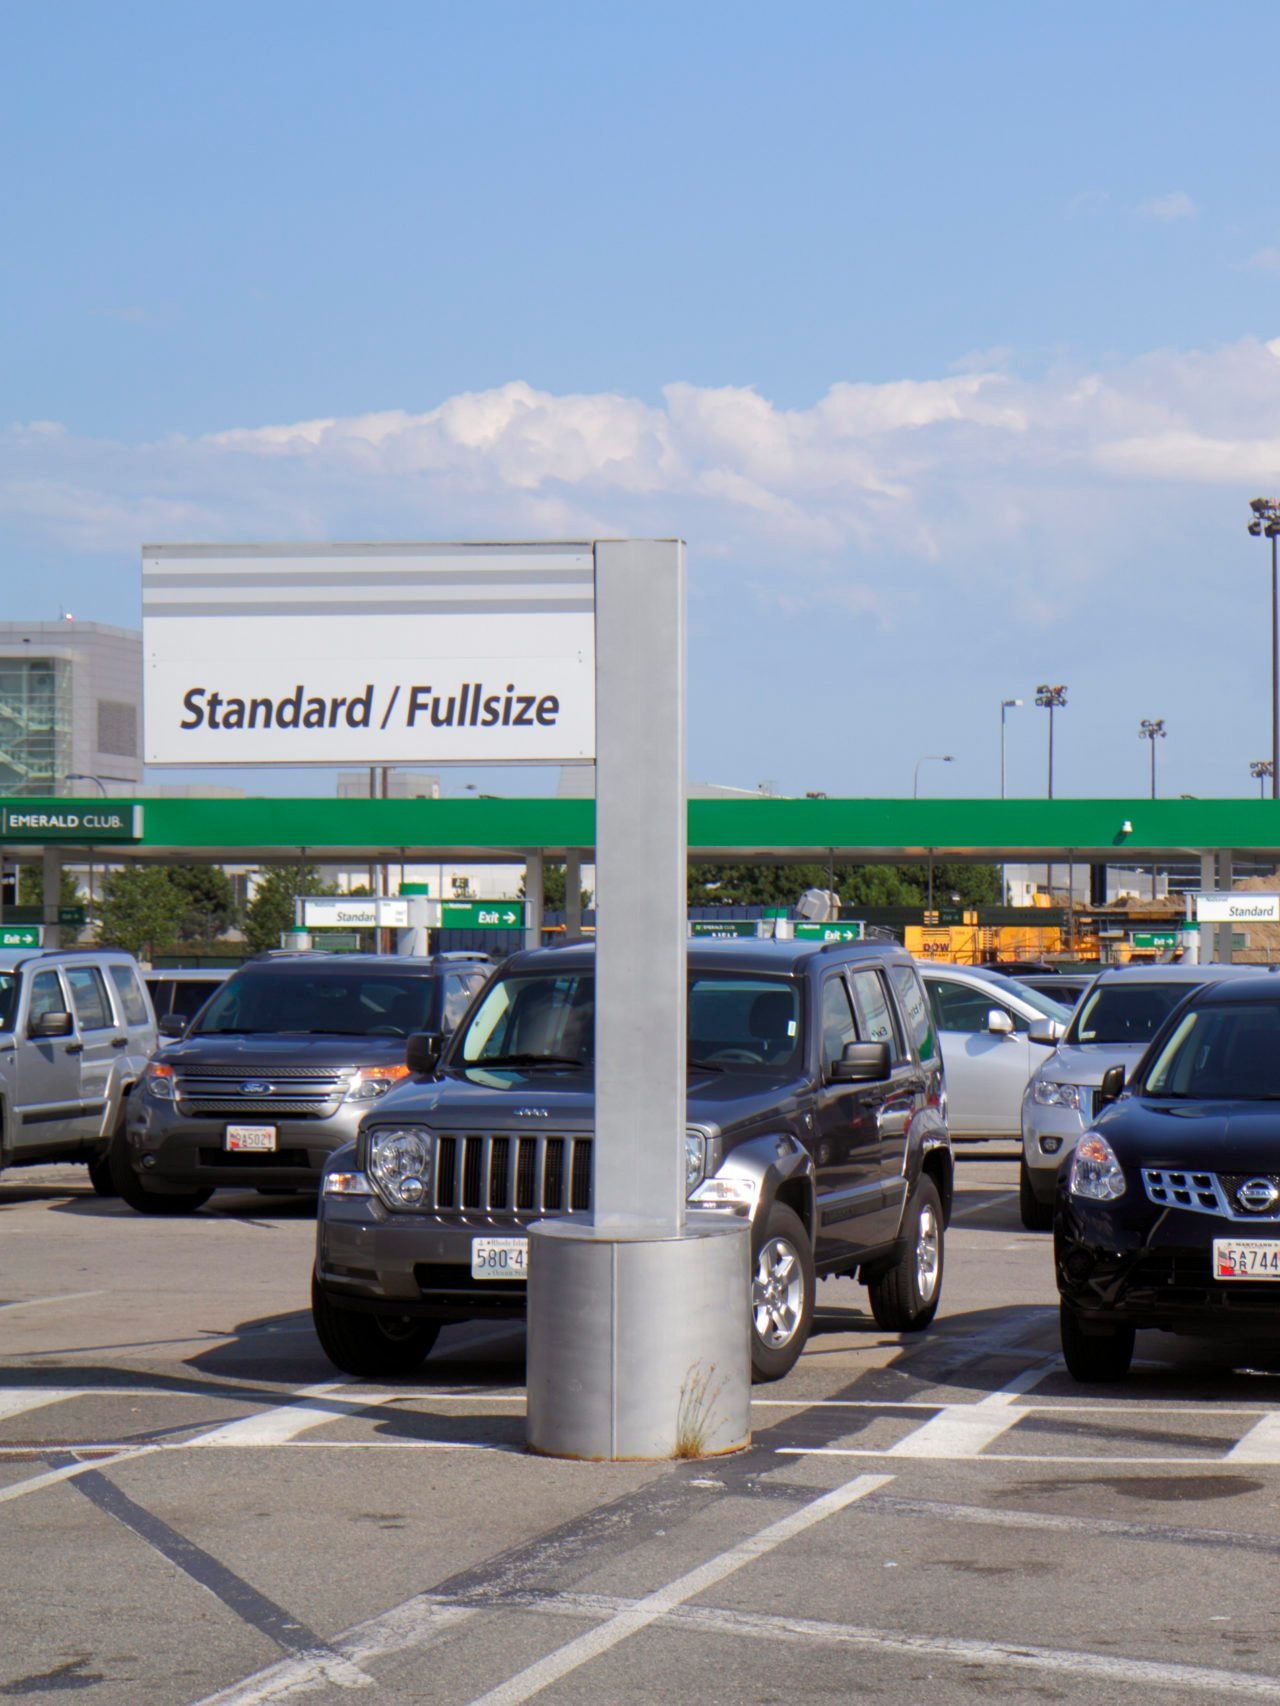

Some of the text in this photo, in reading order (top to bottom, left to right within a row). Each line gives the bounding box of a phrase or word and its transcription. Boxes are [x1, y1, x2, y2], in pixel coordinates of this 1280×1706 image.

[180, 684, 374, 729] Standard
[406, 683, 560, 728] Fullsize
[9, 815, 121, 828] EMERALD CLUB
[337, 911, 376, 922] Standar
[1229, 906, 1274, 917] Standard
[478, 911, 500, 924] Exit
[3, 933, 21, 944] Exit
[824, 930, 842, 940] Exit
[923, 943, 950, 952] DOW
[477, 1248, 528, 1268] 580-4
